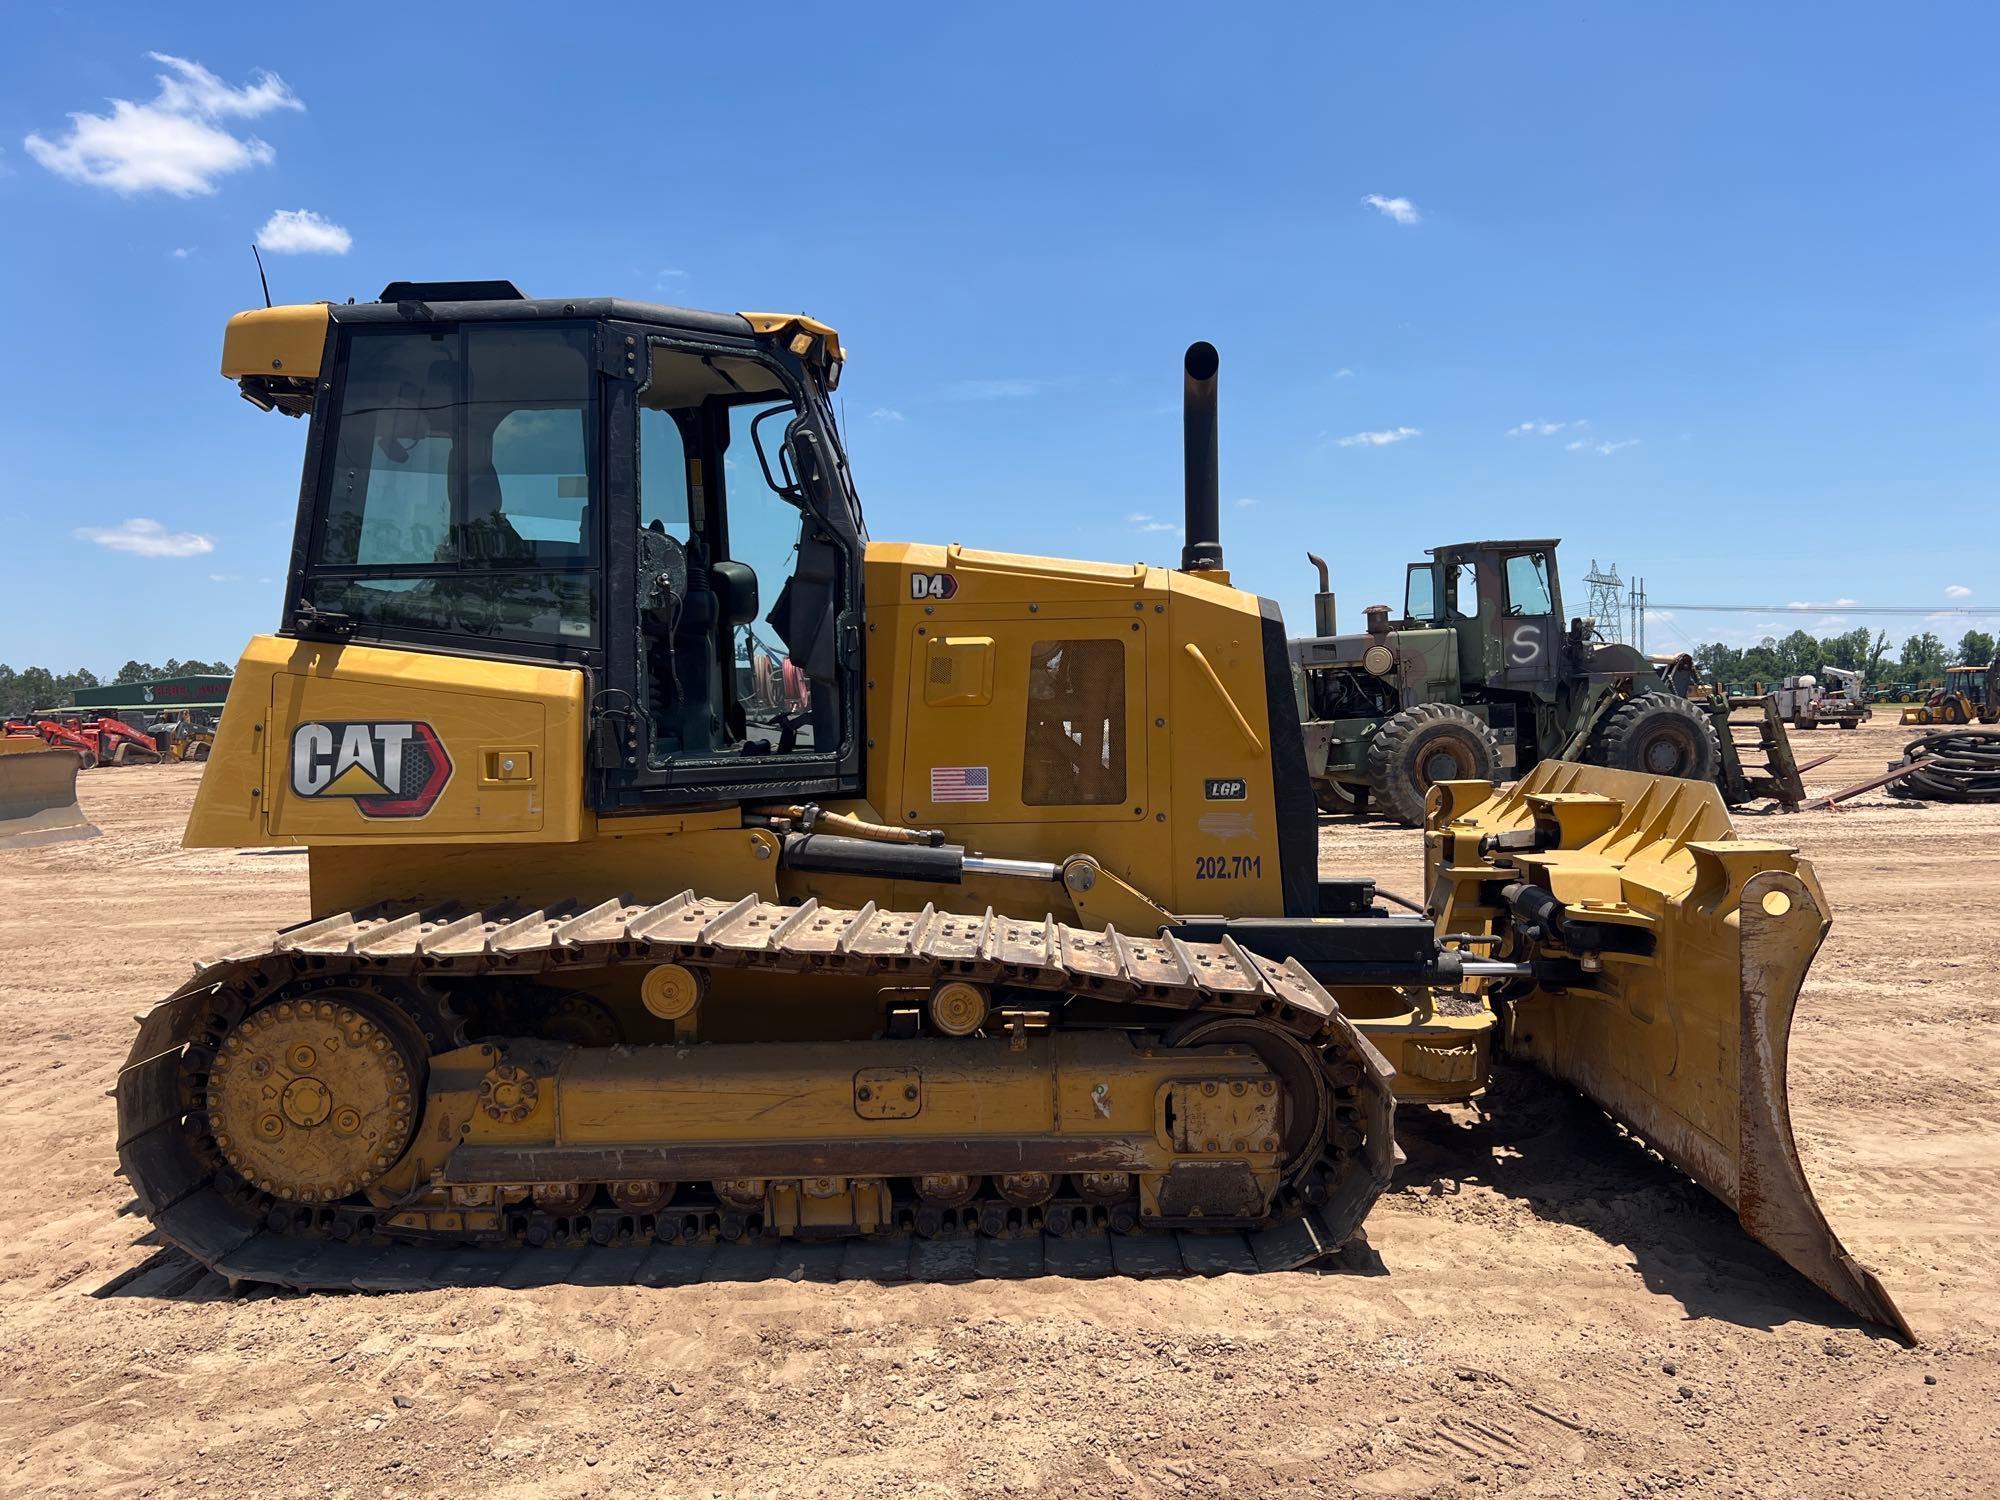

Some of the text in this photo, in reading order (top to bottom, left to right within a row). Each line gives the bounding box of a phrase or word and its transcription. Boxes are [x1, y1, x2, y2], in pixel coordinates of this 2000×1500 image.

[912, 574, 944, 598] D4
[1511, 624, 1541, 664] S
[294, 723, 413, 795] CAT
[1212, 782, 1241, 796] LGP
[1195, 855, 1262, 880] 202.701
